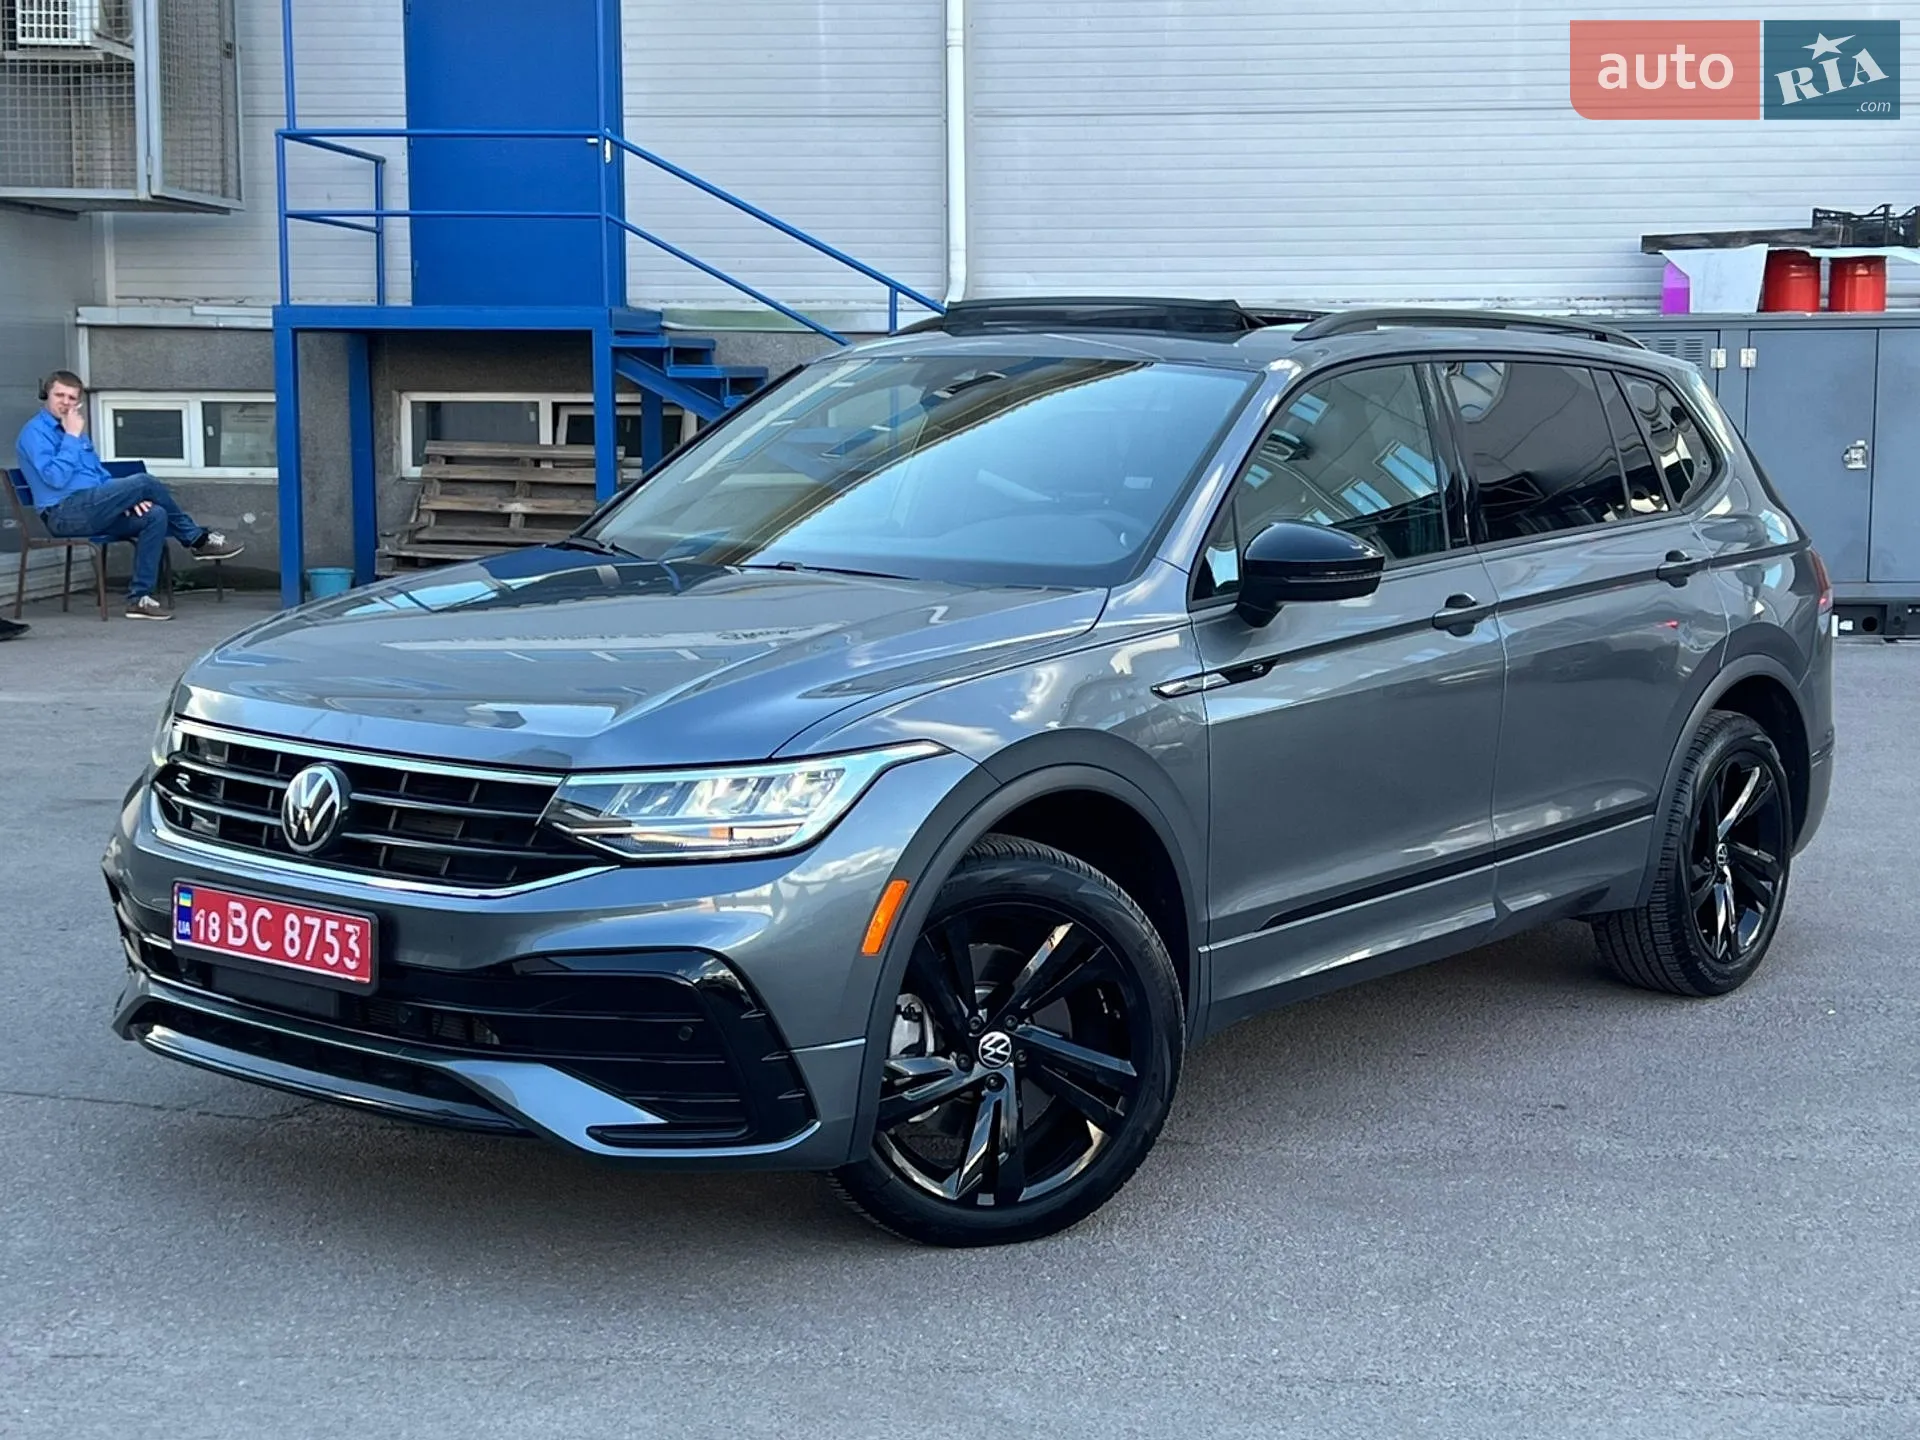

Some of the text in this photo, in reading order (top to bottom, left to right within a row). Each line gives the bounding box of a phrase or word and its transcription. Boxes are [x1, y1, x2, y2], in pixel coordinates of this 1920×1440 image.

[178, 920, 191, 935] UA
[194, 901, 361, 970] 18 BC 8753
